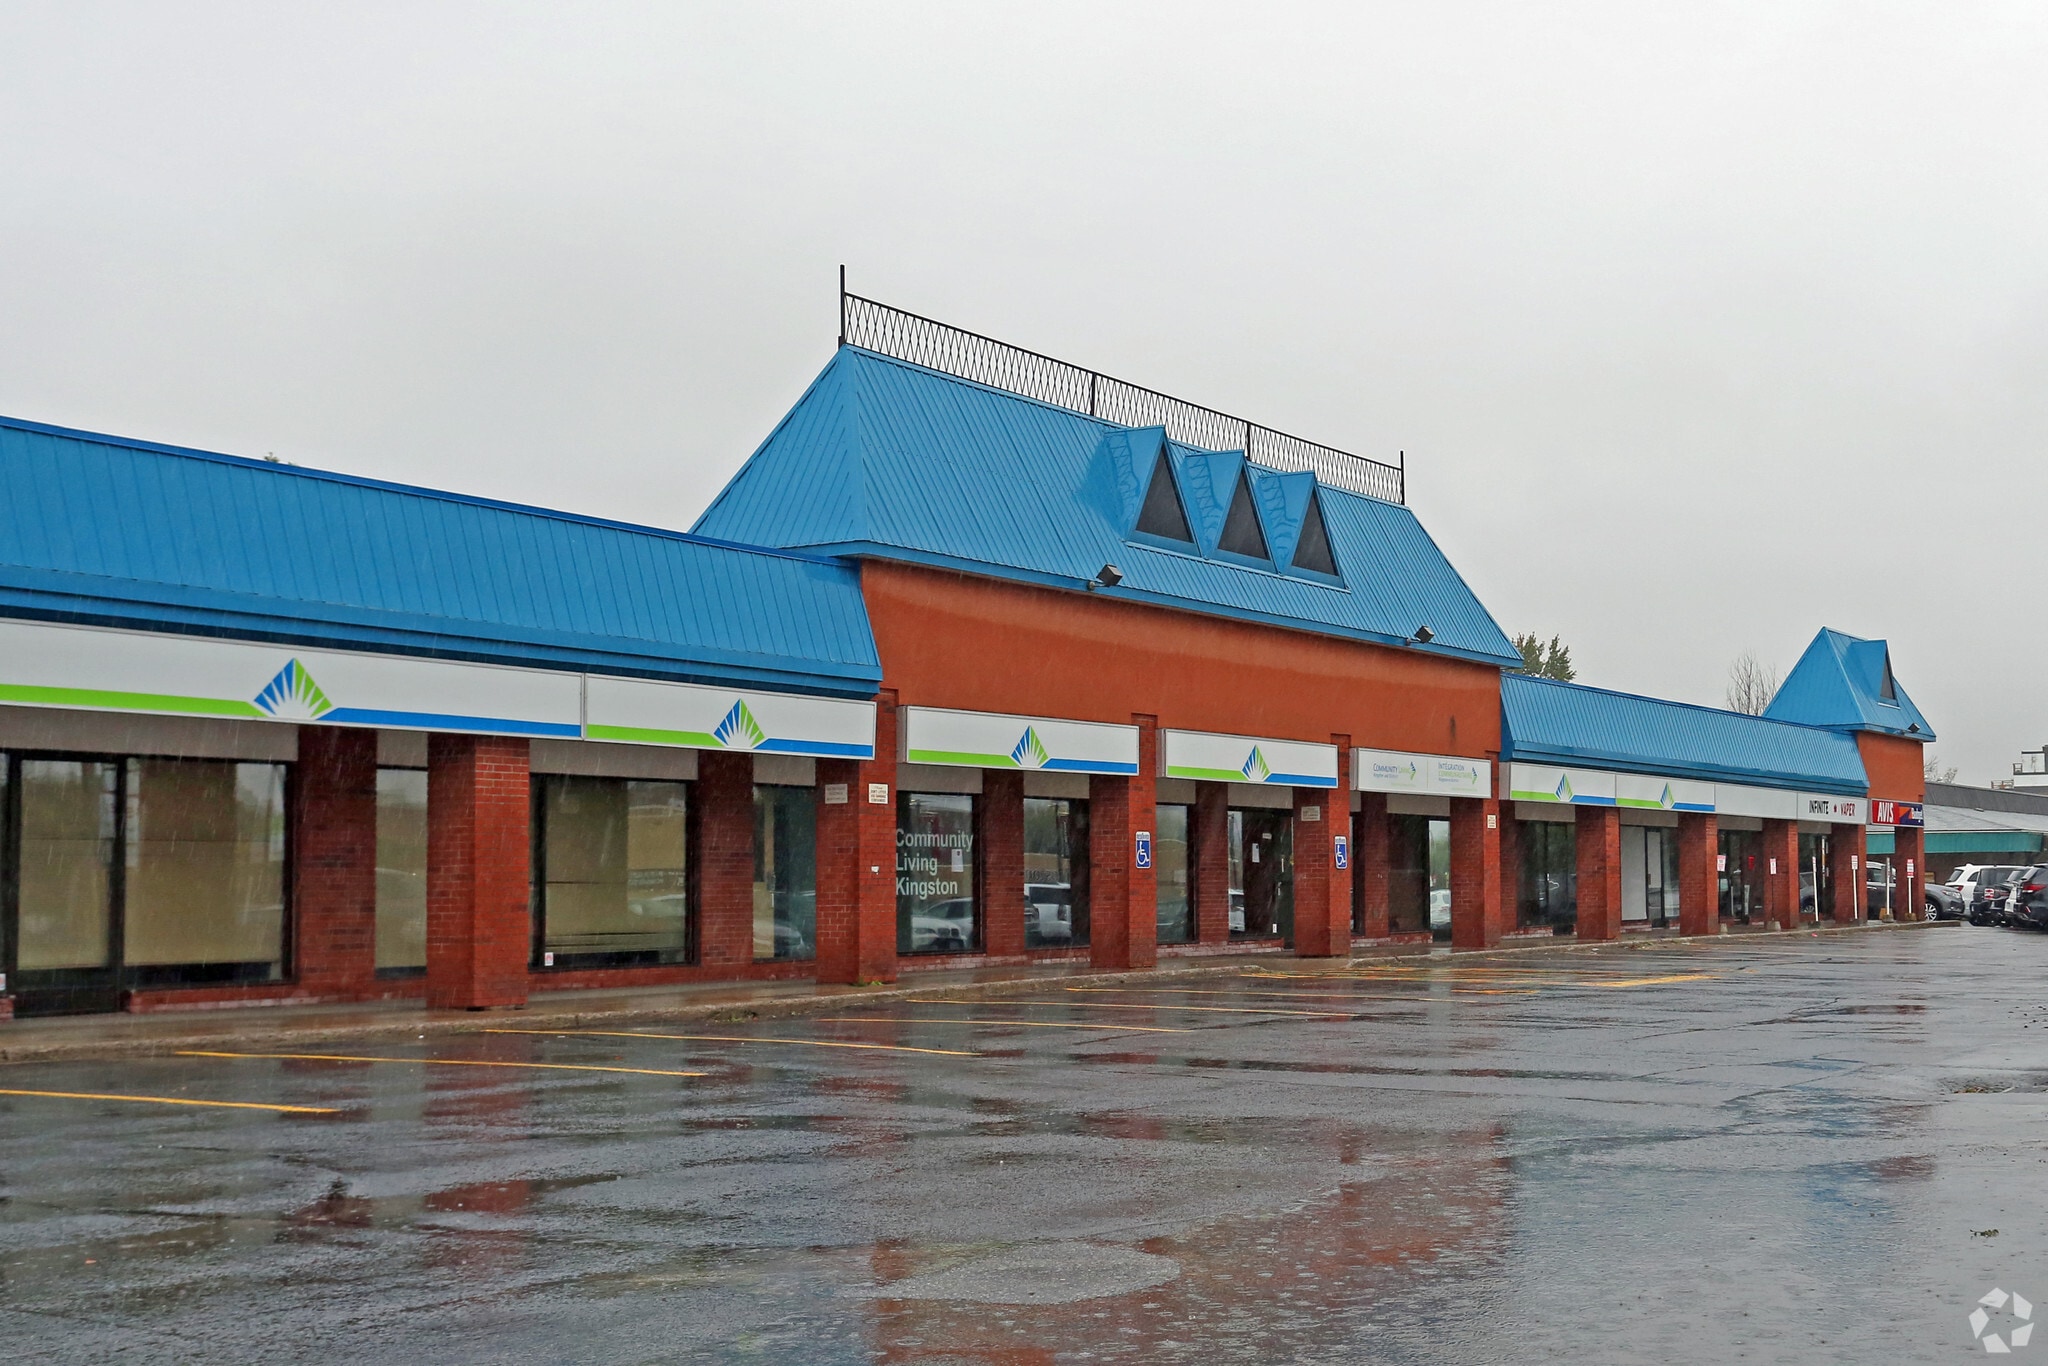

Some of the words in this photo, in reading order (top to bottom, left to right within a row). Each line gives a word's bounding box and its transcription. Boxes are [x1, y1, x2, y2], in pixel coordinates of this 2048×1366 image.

[1809, 800, 1829, 814] INFINITE
[1840, 802, 1856, 816] VAPER
[1877, 802, 1894, 823] AVIS
[896, 828, 974, 852] Community
[896, 852, 938, 876] Living
[896, 876, 958, 900] Kingston
